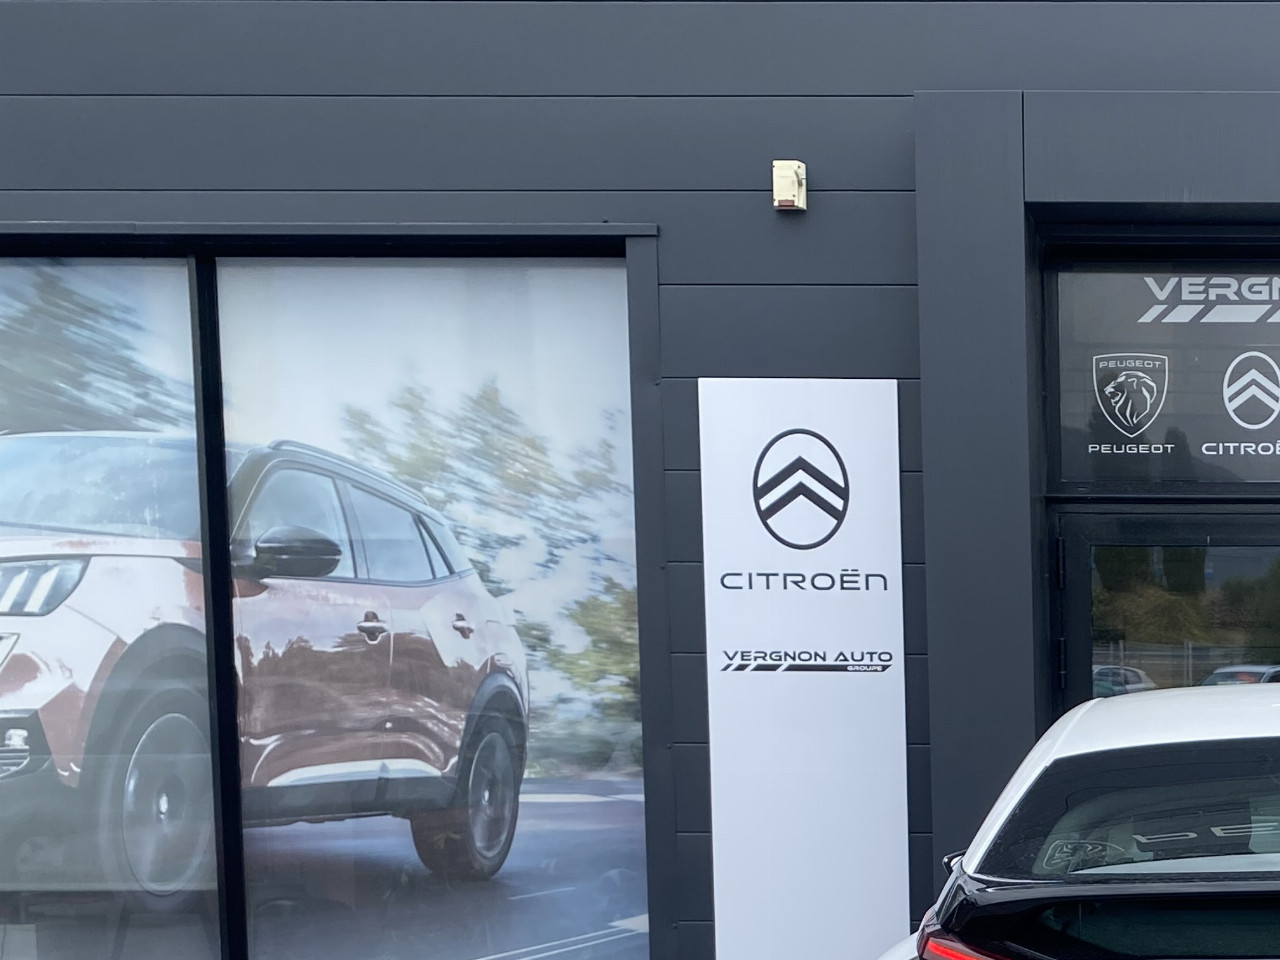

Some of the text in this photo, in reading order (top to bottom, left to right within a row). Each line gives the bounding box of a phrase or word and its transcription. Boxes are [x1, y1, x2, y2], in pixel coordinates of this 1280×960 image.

[1099, 360, 1162, 369] PEUGEOT
[1088, 444, 1175, 454] PEUGEOT
[723, 650, 893, 662] VERGNON AUTO
